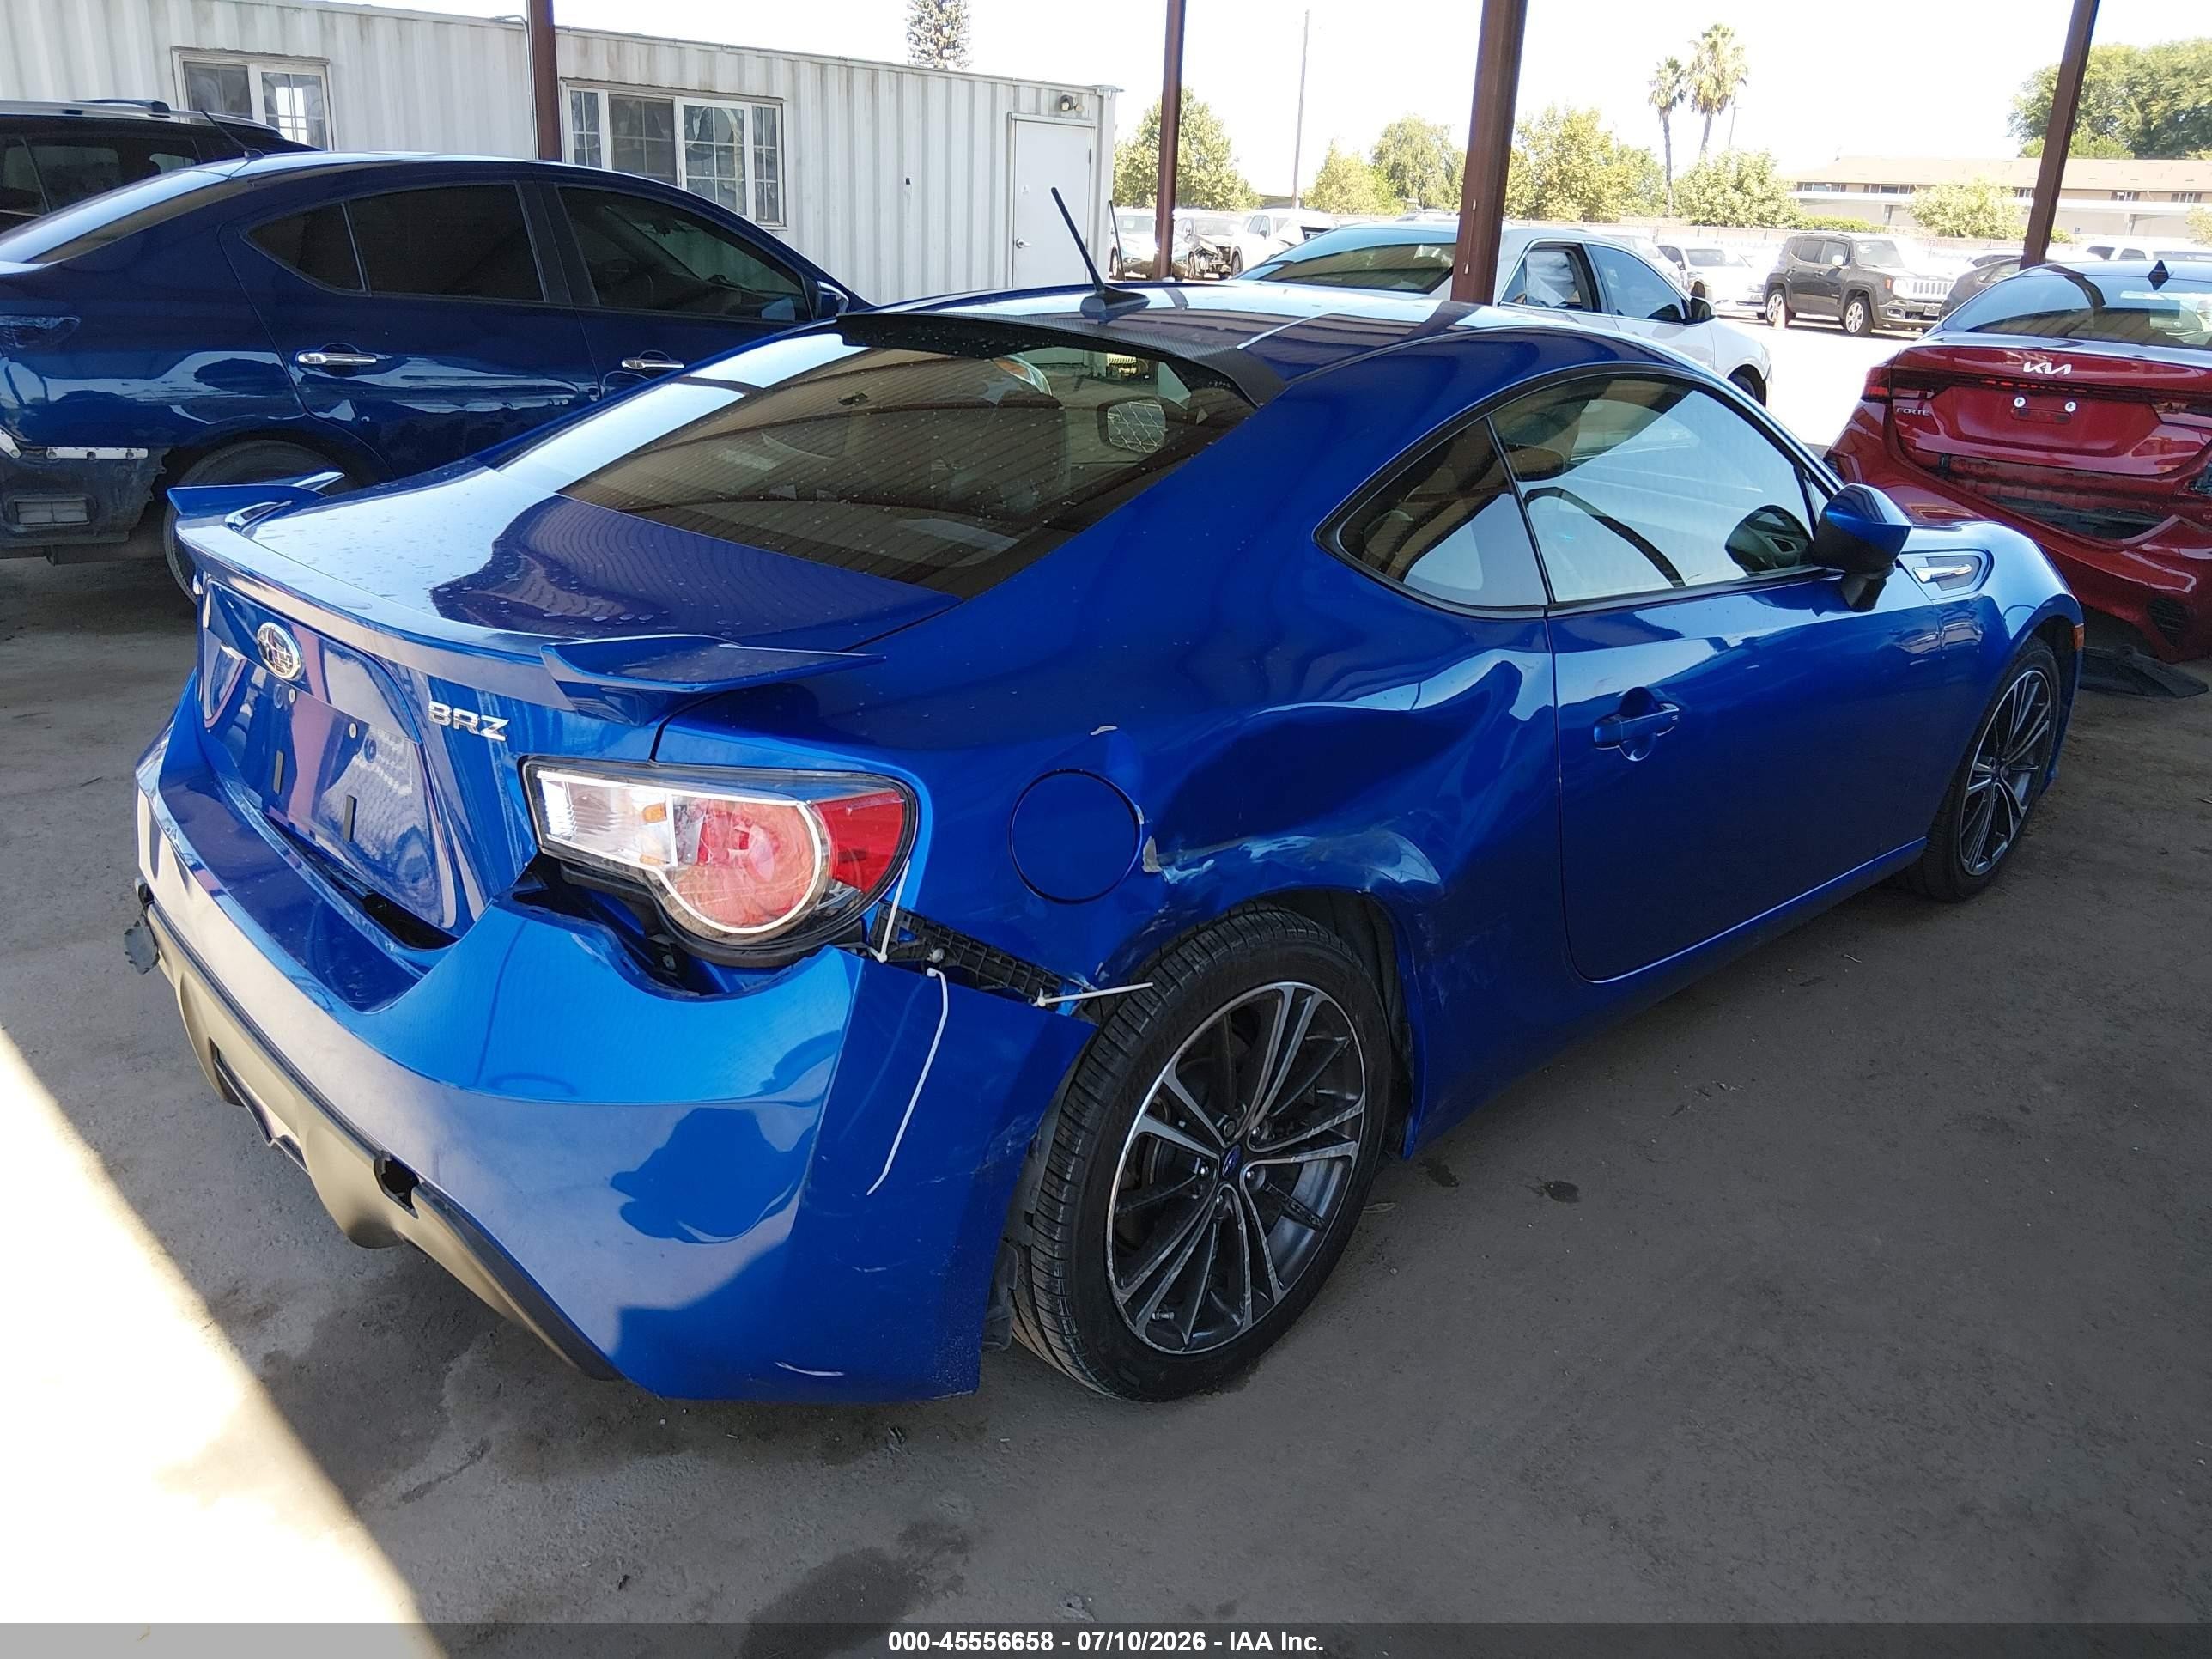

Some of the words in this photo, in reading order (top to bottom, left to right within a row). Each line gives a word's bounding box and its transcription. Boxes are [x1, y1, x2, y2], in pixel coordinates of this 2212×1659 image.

[2023, 361, 2072, 375] KIA
[1896, 407, 1930, 416] FORTE
[428, 700, 510, 742] BRZ
